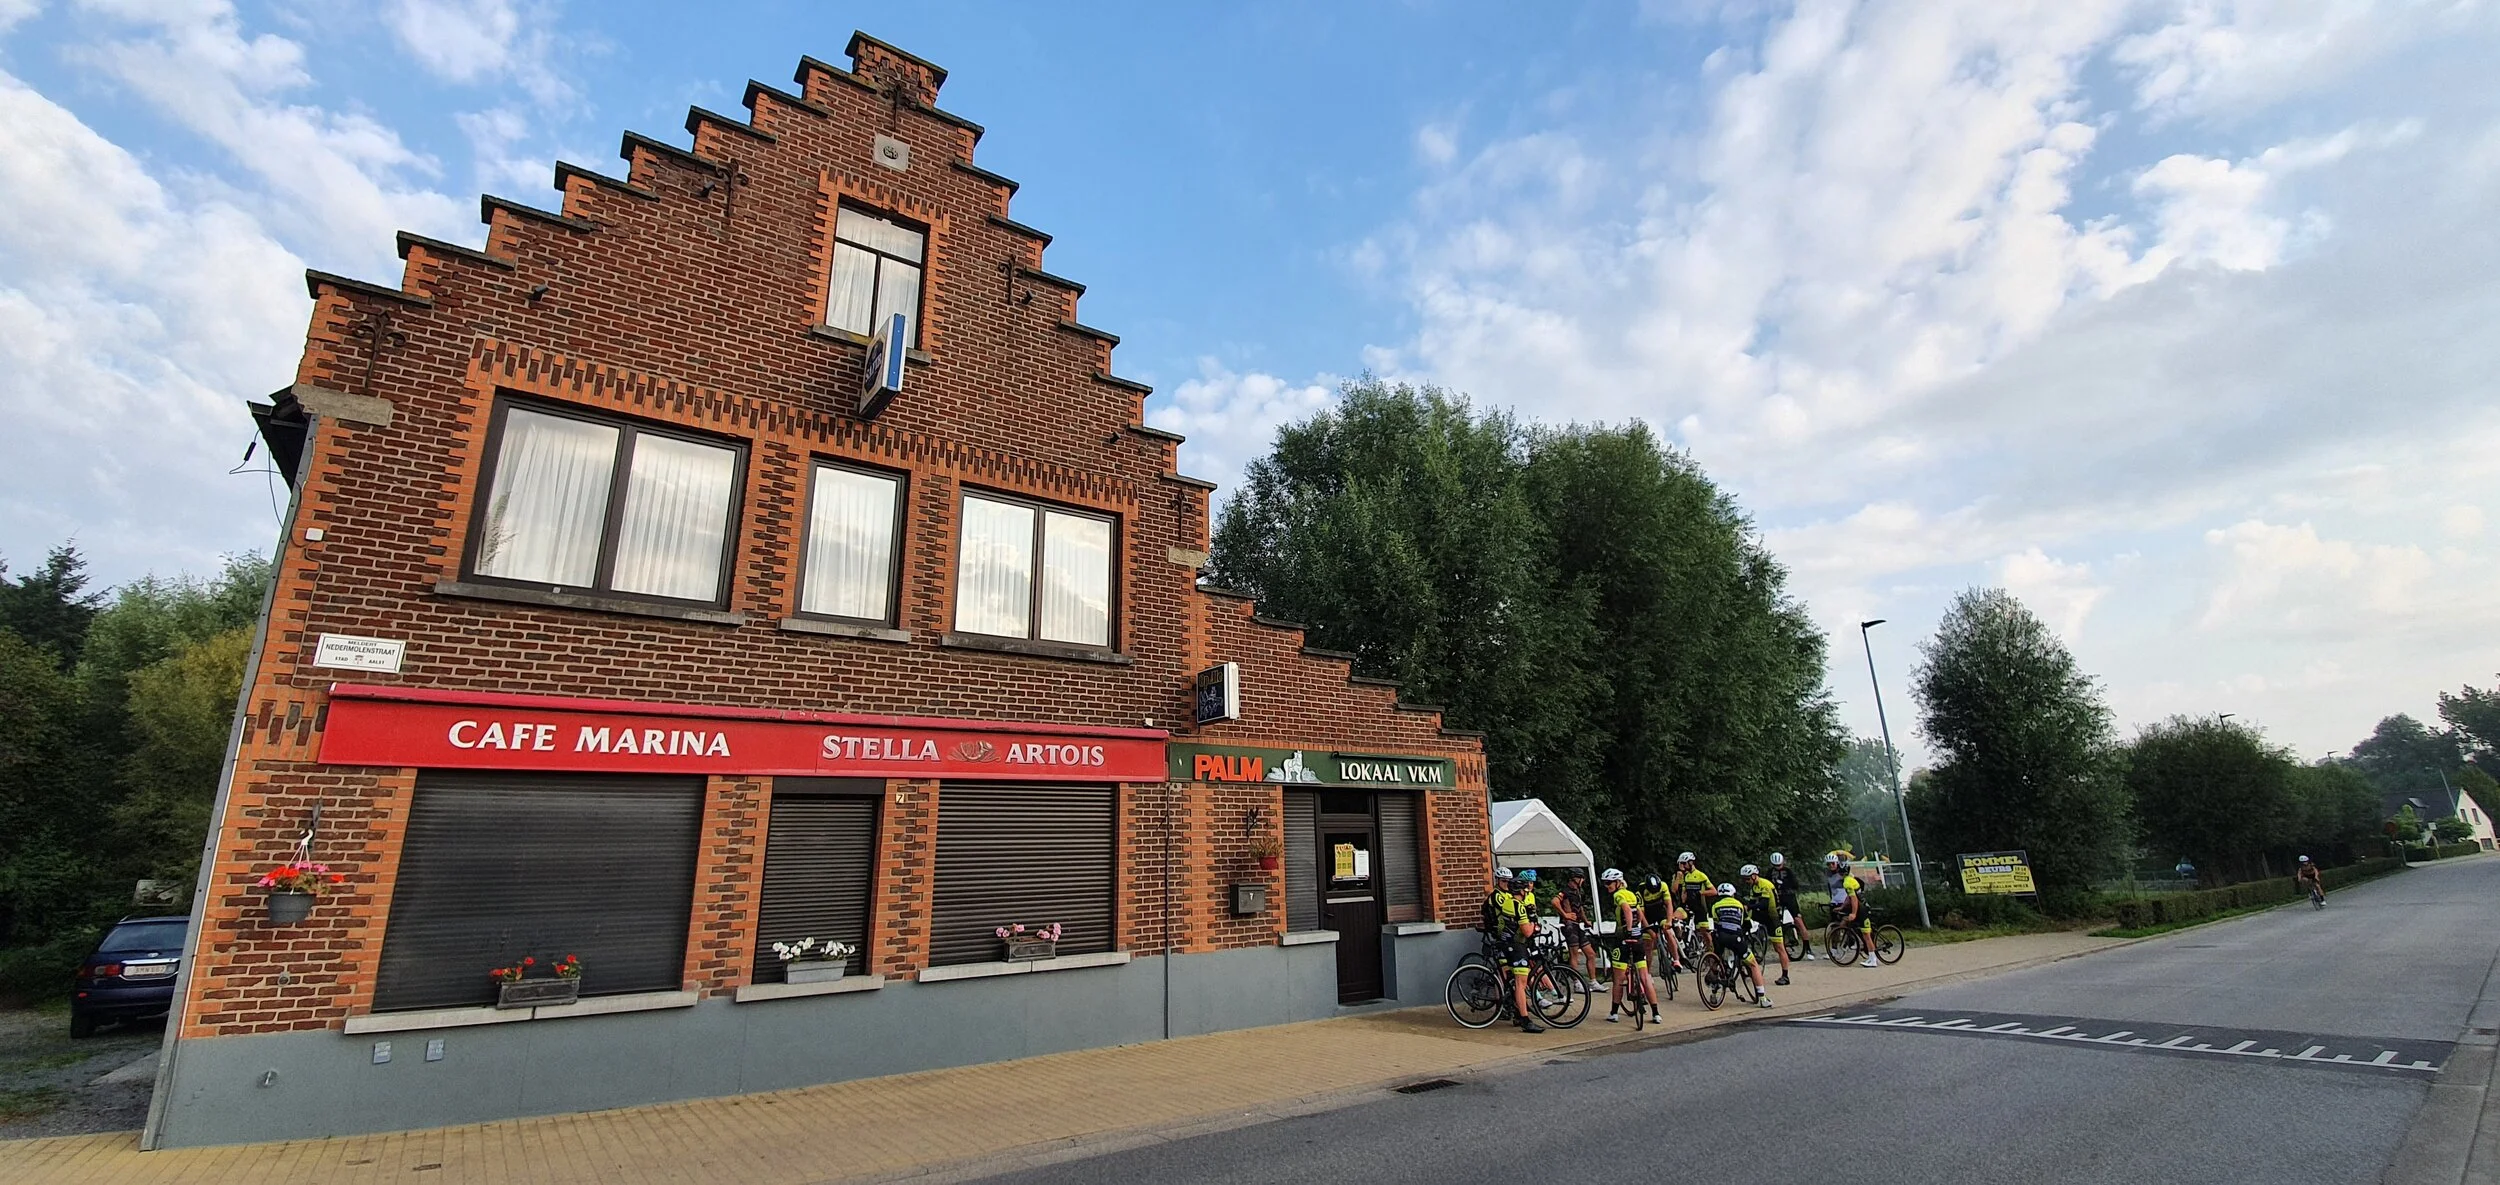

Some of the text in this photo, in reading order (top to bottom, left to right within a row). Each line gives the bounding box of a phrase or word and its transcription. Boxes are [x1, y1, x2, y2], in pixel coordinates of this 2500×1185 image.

[325, 644, 395, 655] NEDERMOLENSTRAAT
[448, 720, 731, 757] CAFE MARINA
[822, 735, 1105, 766] STELLA ARTOIS
[1195, 754, 1263, 782] PALM
[1340, 762, 1442, 783] LOKAAL VKM
[1964, 856, 2022, 866] ROMMEL
